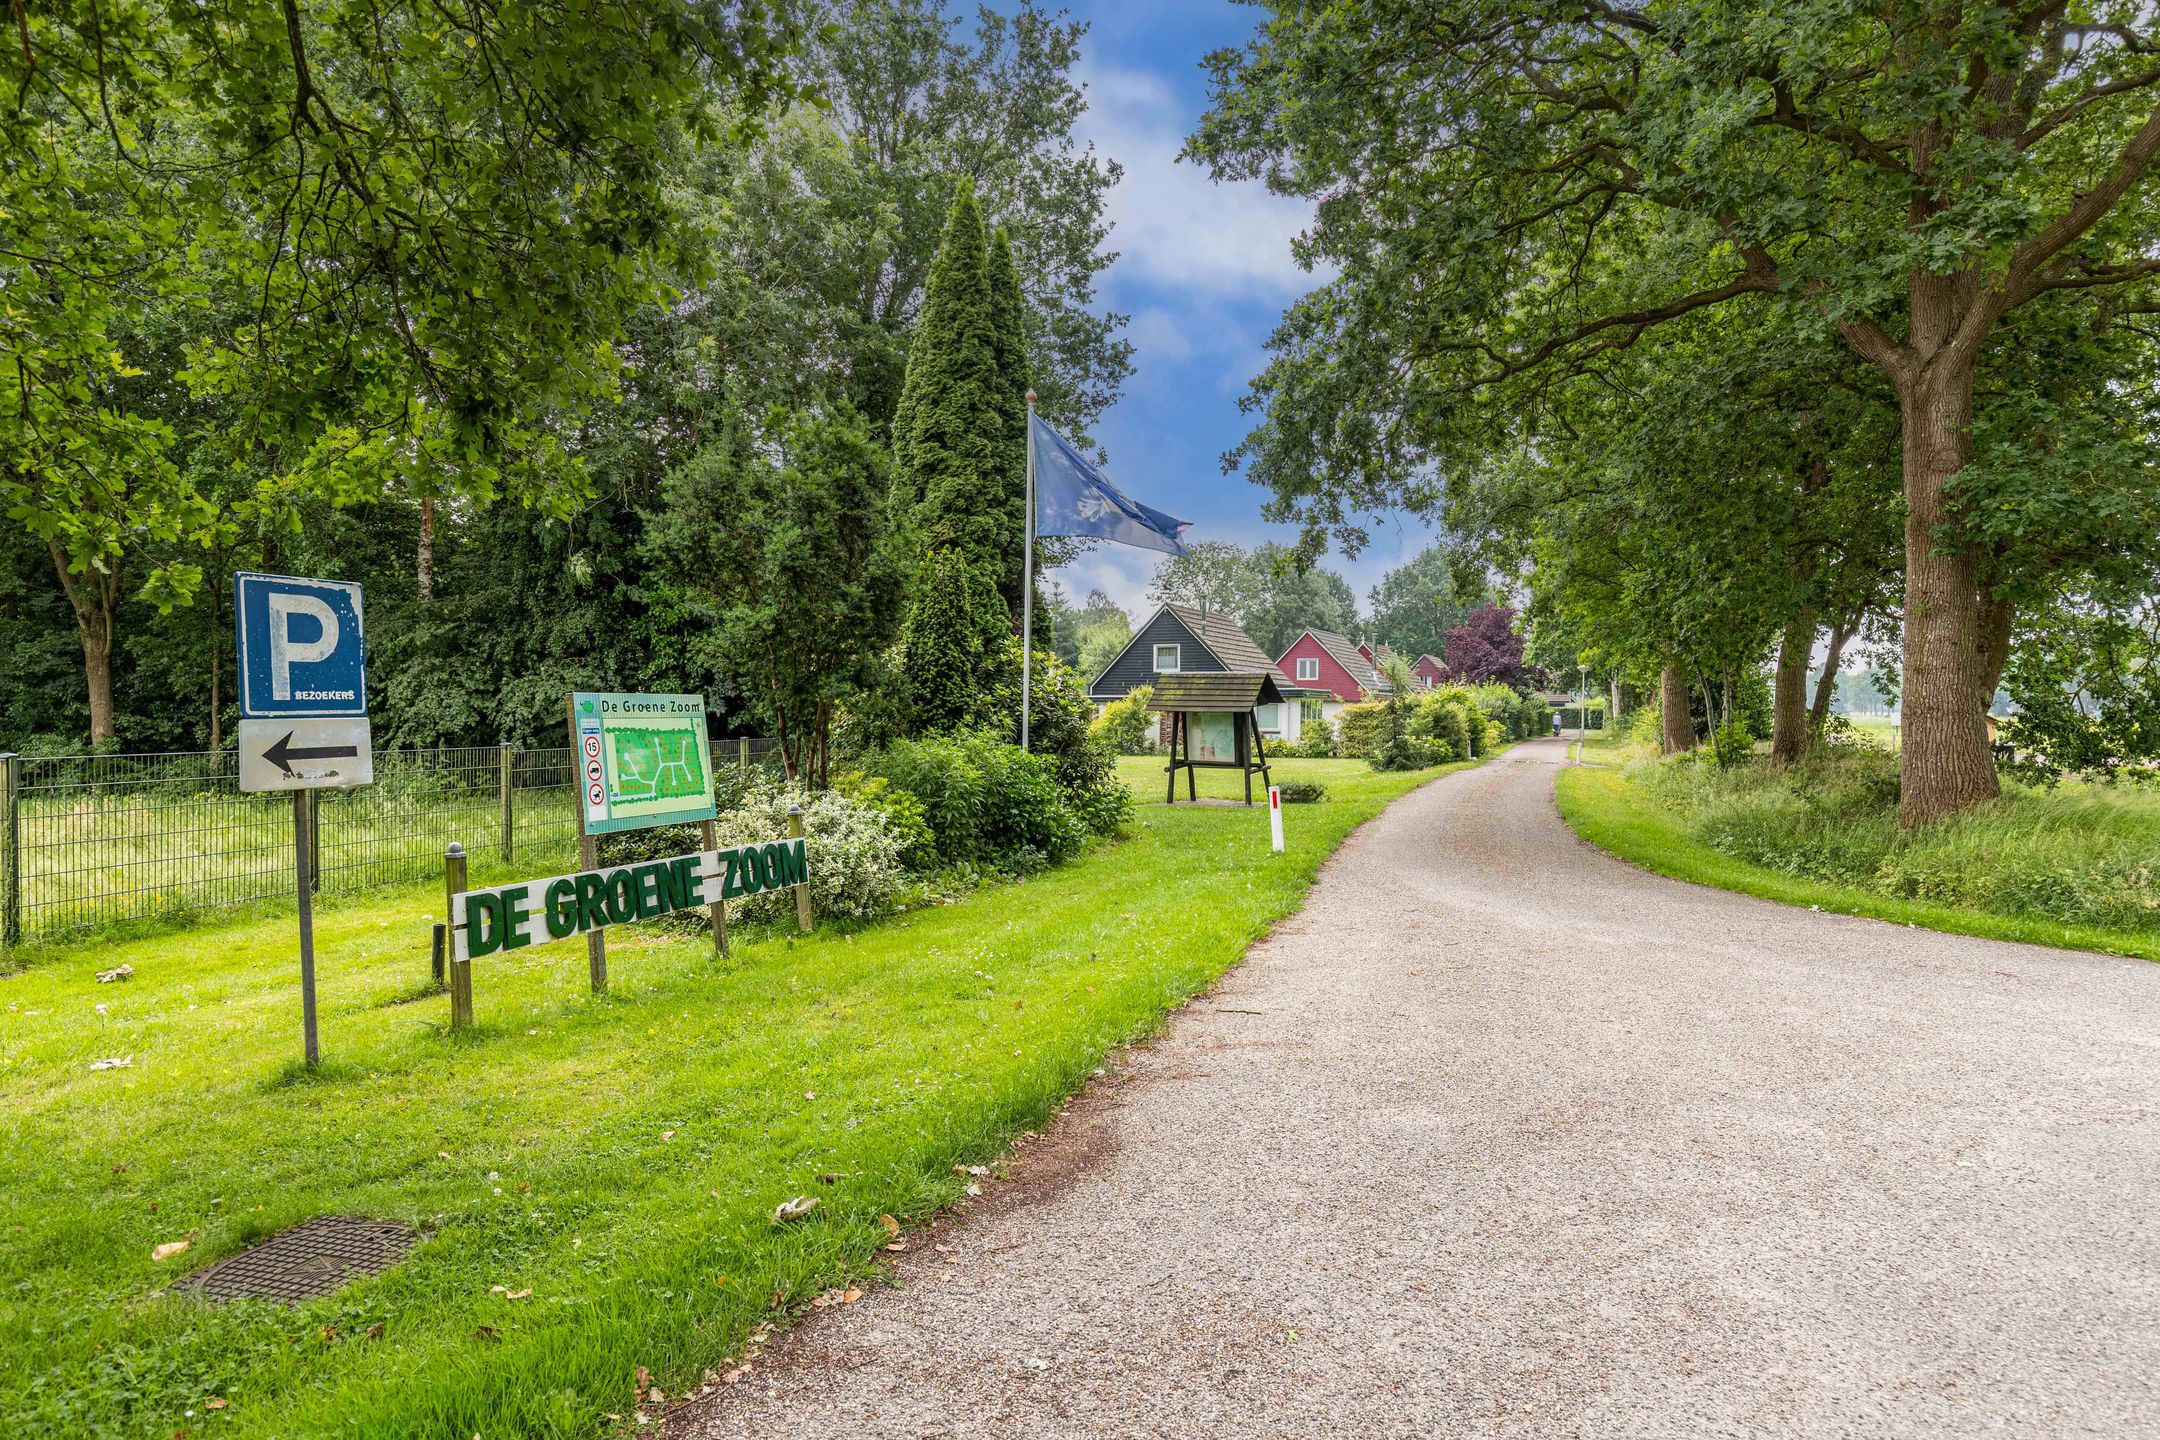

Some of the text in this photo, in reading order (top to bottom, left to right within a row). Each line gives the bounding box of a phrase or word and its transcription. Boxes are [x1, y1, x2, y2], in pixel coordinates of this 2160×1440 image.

[269, 593, 339, 700] P
[295, 690, 355, 700] BEZOEKERS
[602, 701, 700, 712] De Groene Zoom
[587, 742, 597, 752] 15
[465, 840, 808, 958] DE GROENE ZOOM
